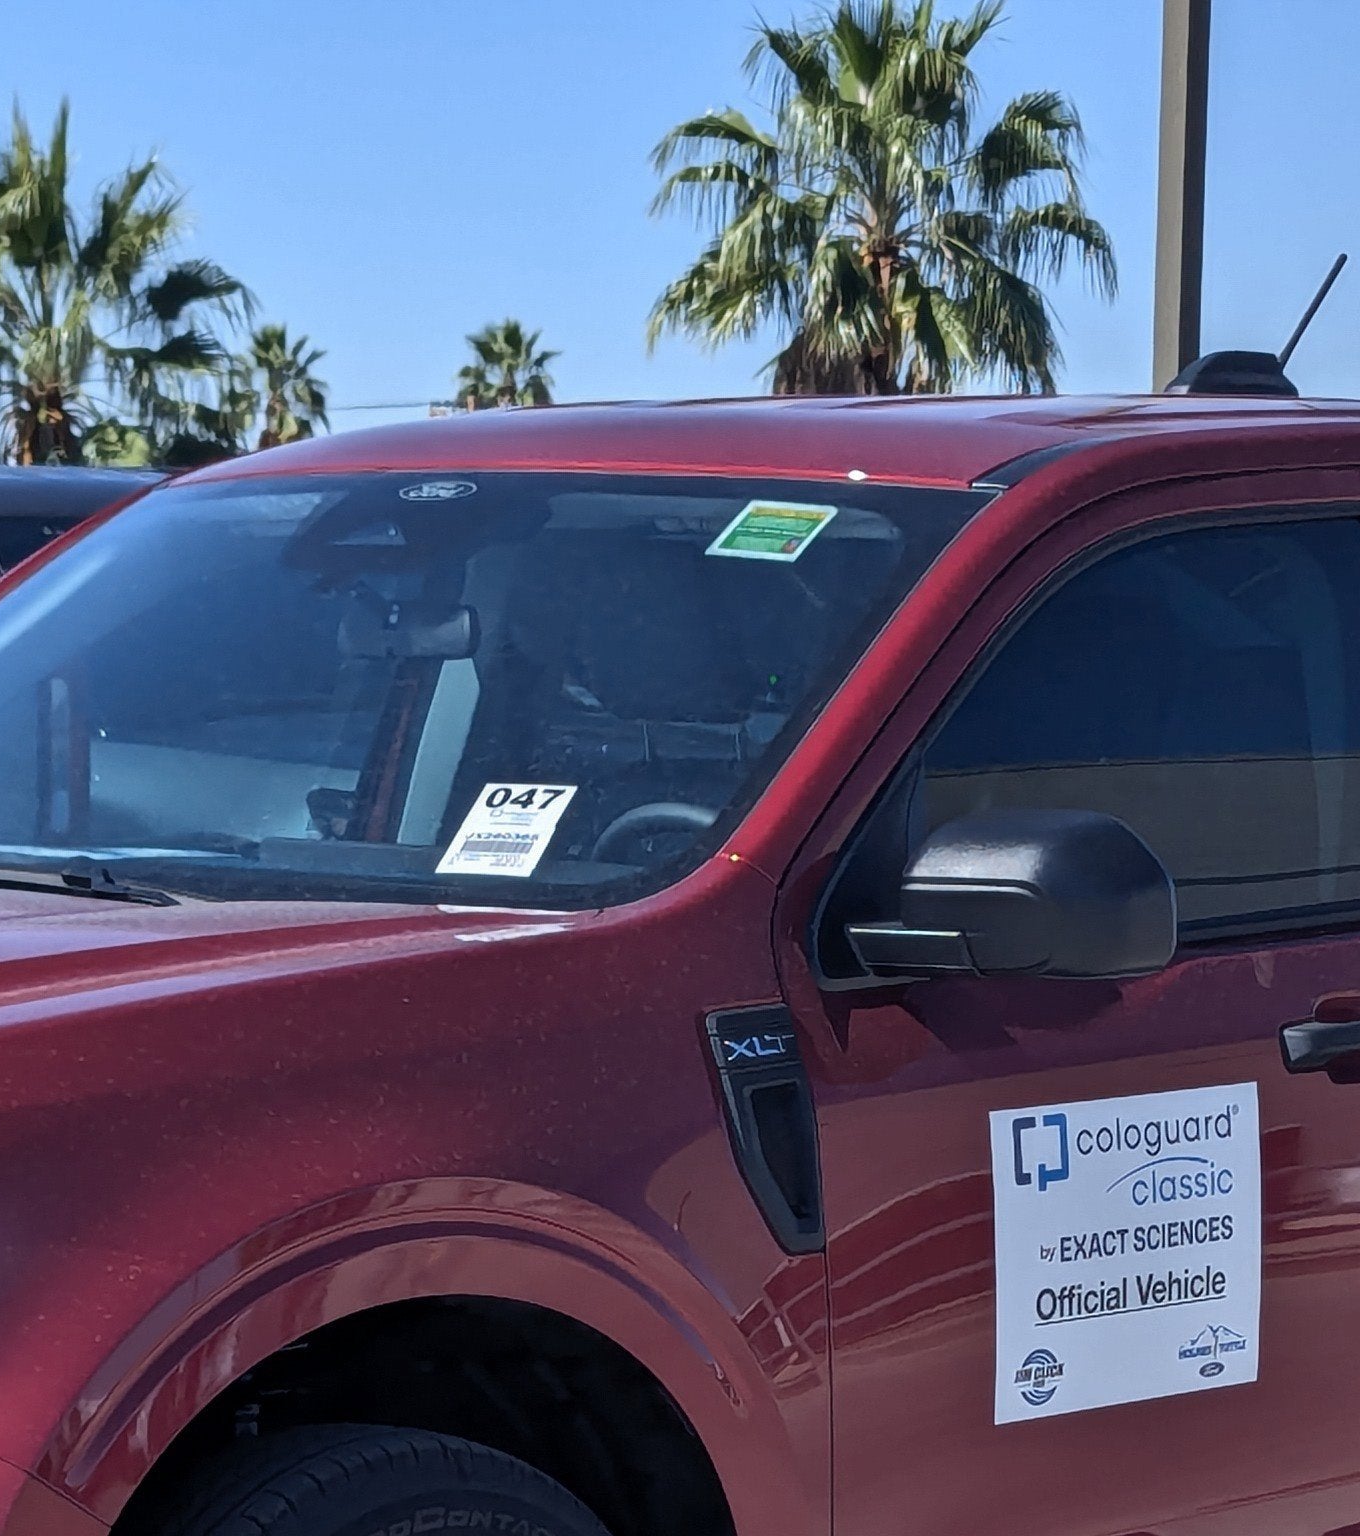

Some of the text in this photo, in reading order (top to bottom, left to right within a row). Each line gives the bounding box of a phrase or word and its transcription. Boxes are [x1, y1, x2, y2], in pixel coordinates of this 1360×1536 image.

[485, 787, 566, 810] 047
[723, 1034, 795, 1061] XLT
[1132, 1161, 1233, 1205] classic
[1040, 1214, 1234, 1262] by EXACT SCIENCES
[1036, 1265, 1226, 1320] Official Vehicle
